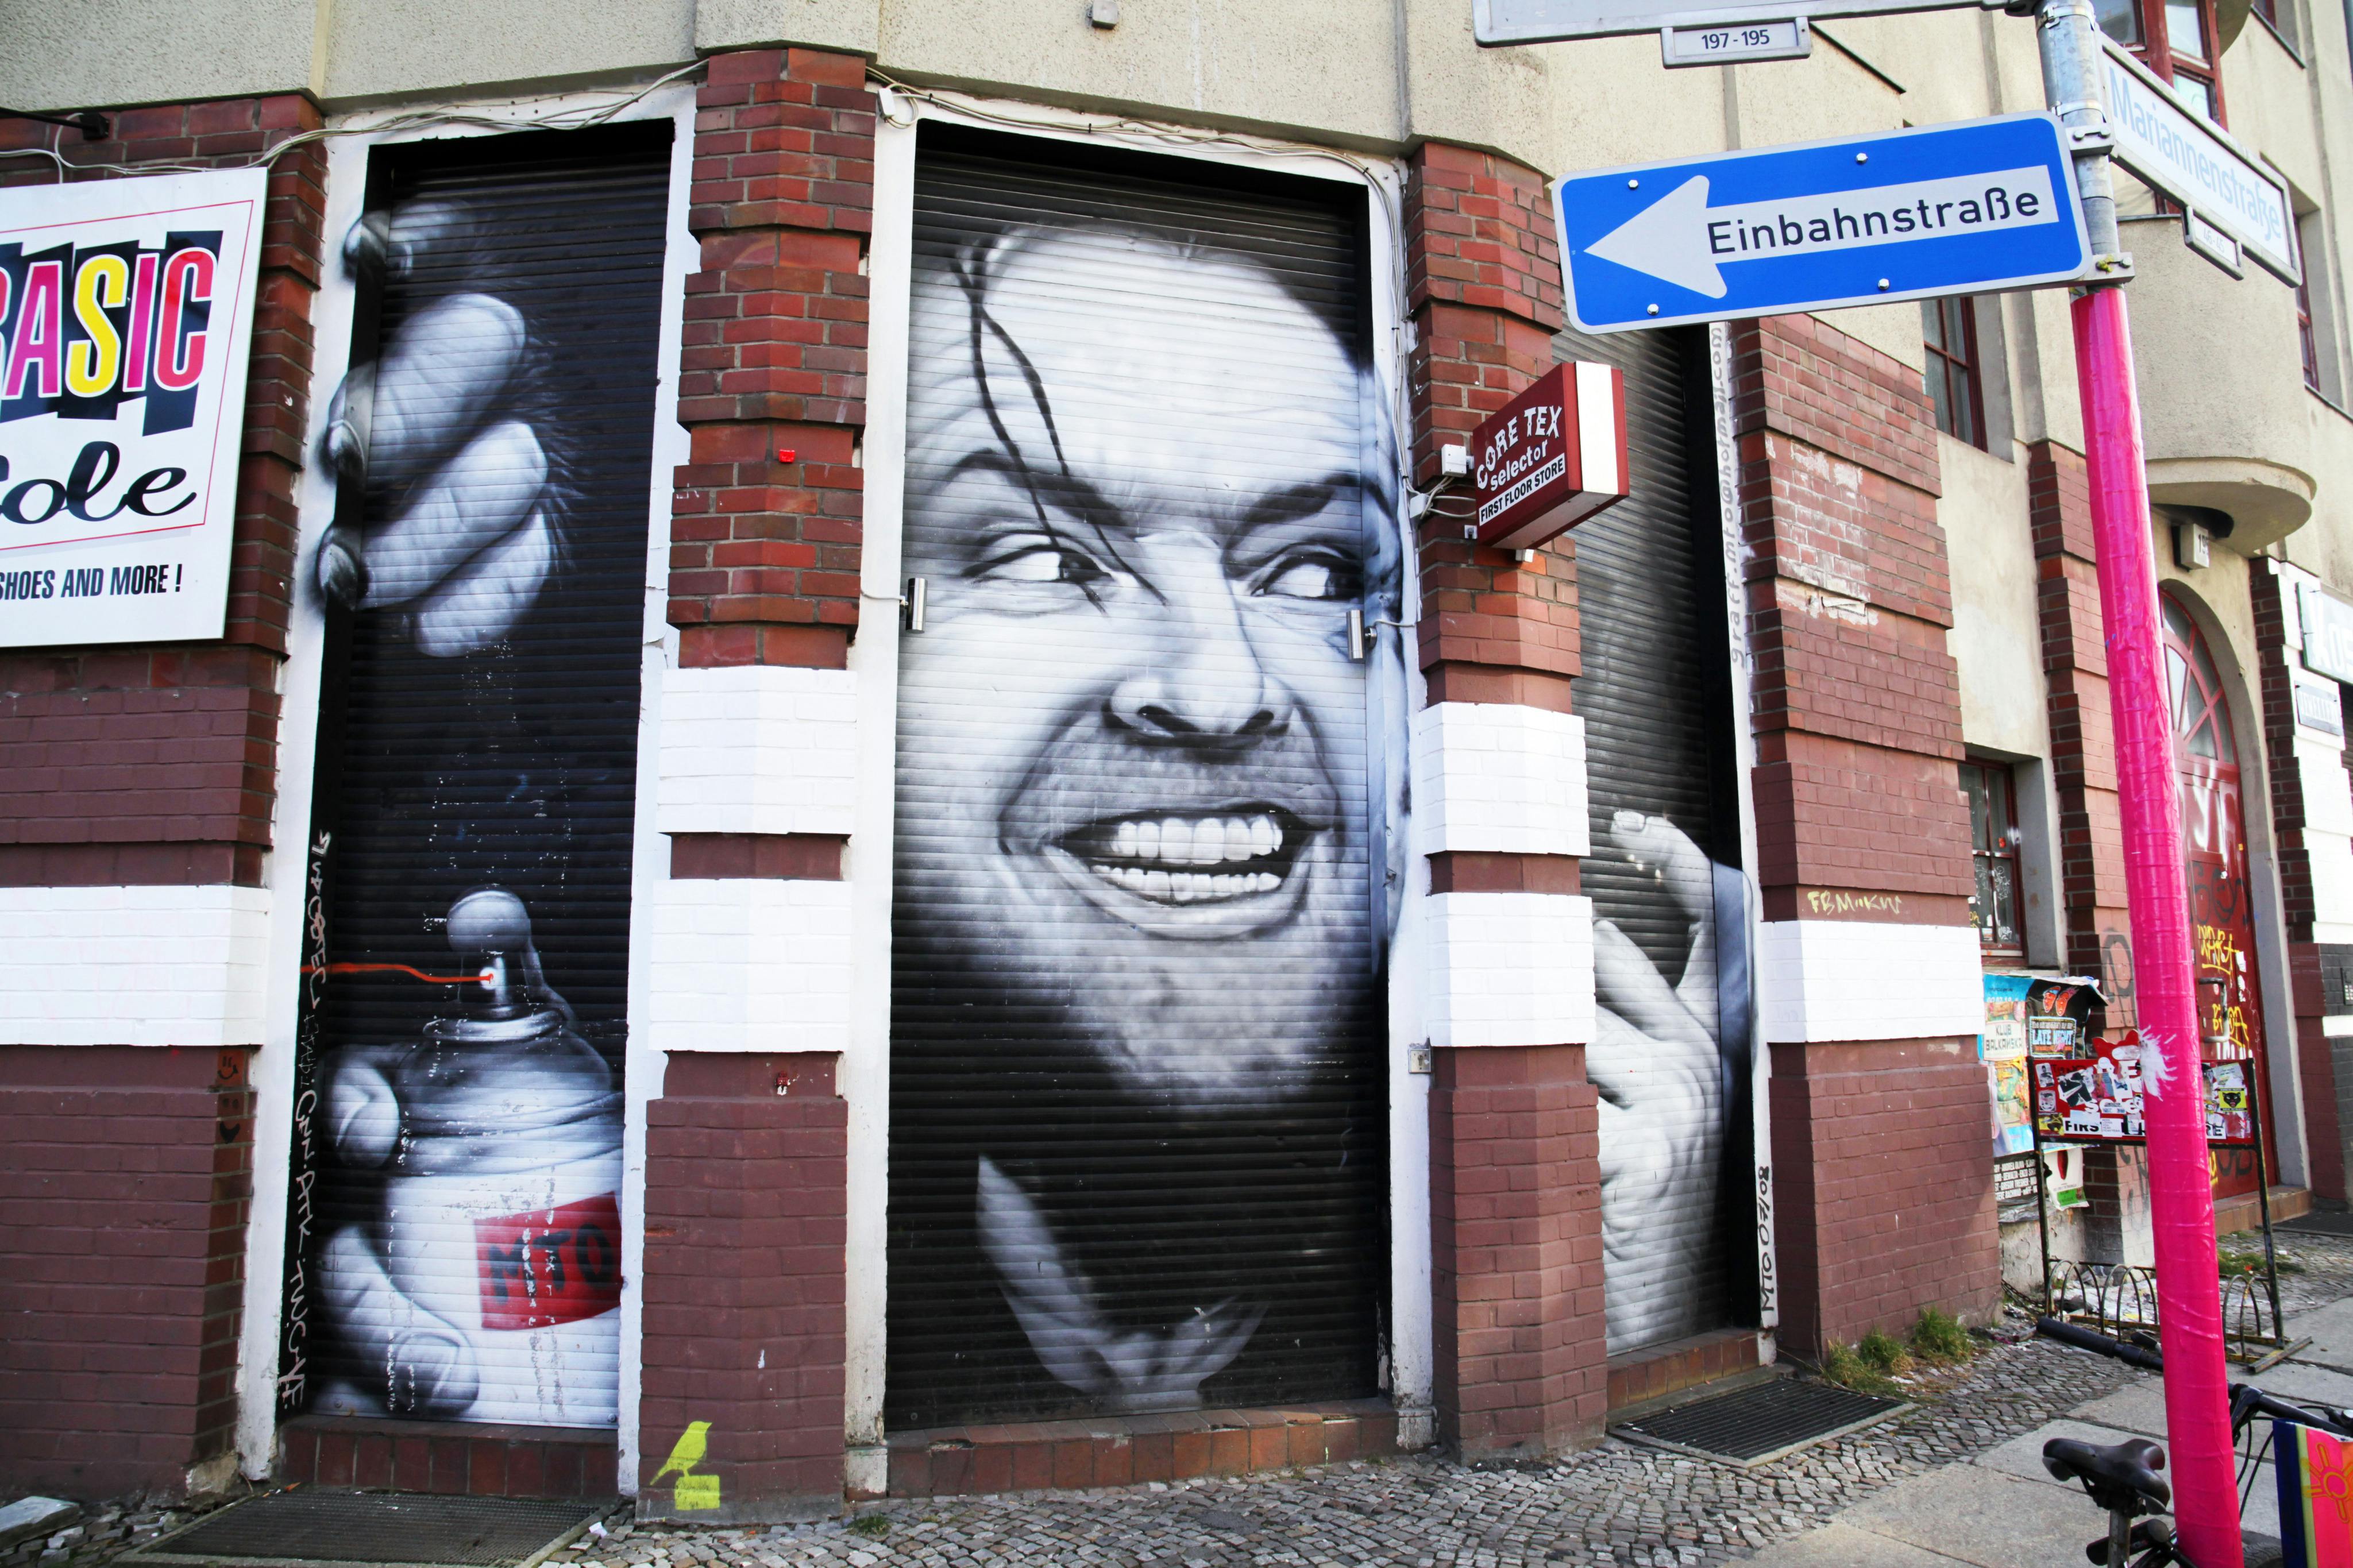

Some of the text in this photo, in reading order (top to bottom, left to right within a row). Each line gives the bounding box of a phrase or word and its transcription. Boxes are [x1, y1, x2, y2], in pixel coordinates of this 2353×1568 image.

[2109, 65, 2281, 241] Mariannenstraße
[1707, 187, 2039, 254] Einbahnstraße
[0, 246, 218, 400] ASIC
[1477, 405, 1563, 489] CORE TEX
[1490, 439, 1548, 492] selector
[0, 441, 197, 525] ole
[1480, 457, 1564, 522] FIRST FLOOR STORE
[60, 567, 104, 598] AND
[1995, 1024, 2011, 1036] KLUB
[2032, 1029, 2074, 1045] LATE NIGHT
[2065, 1121, 2102, 1132] FIRS
[488, 1222, 615, 1306] MTO
[1761, 1252, 1775, 1312] MTO
